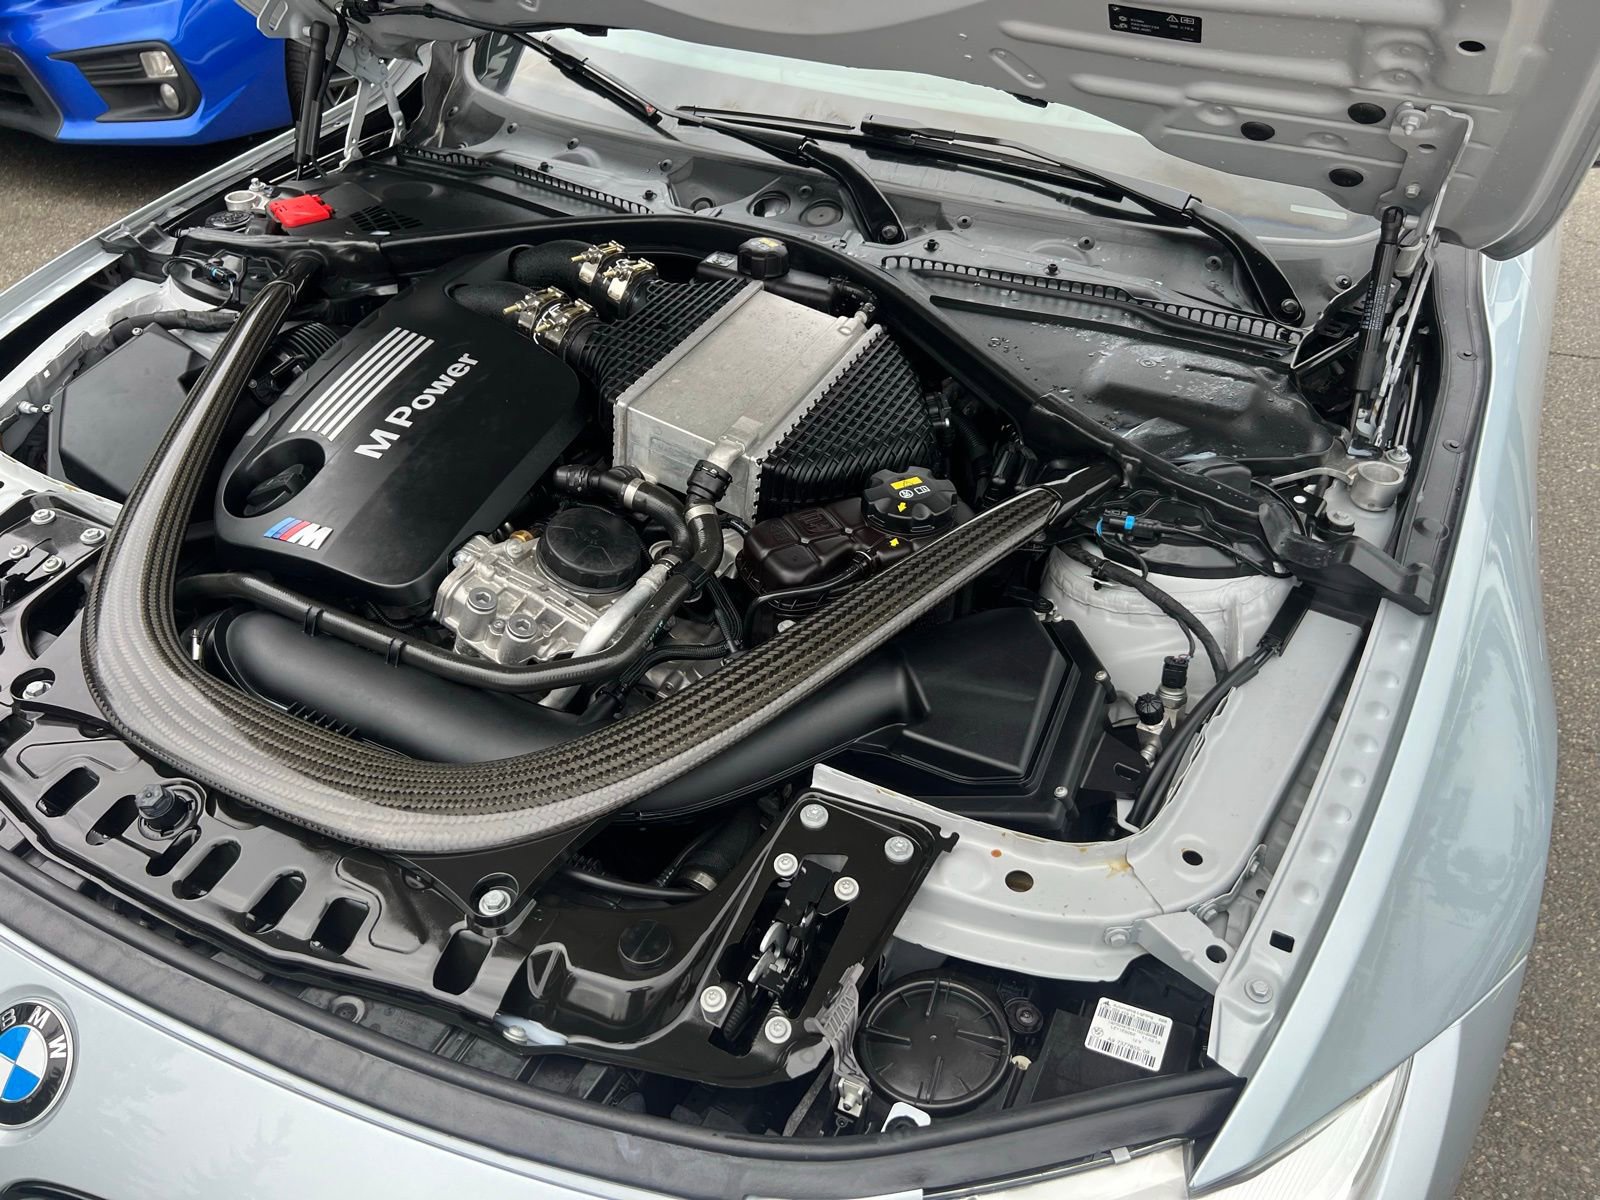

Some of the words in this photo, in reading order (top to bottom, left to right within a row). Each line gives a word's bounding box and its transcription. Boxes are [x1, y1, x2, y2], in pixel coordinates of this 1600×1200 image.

[354, 428, 400, 459] M
[384, 353, 479, 428] Power
[285, 522, 334, 550] M
[0, 1005, 67, 1059] BMW
